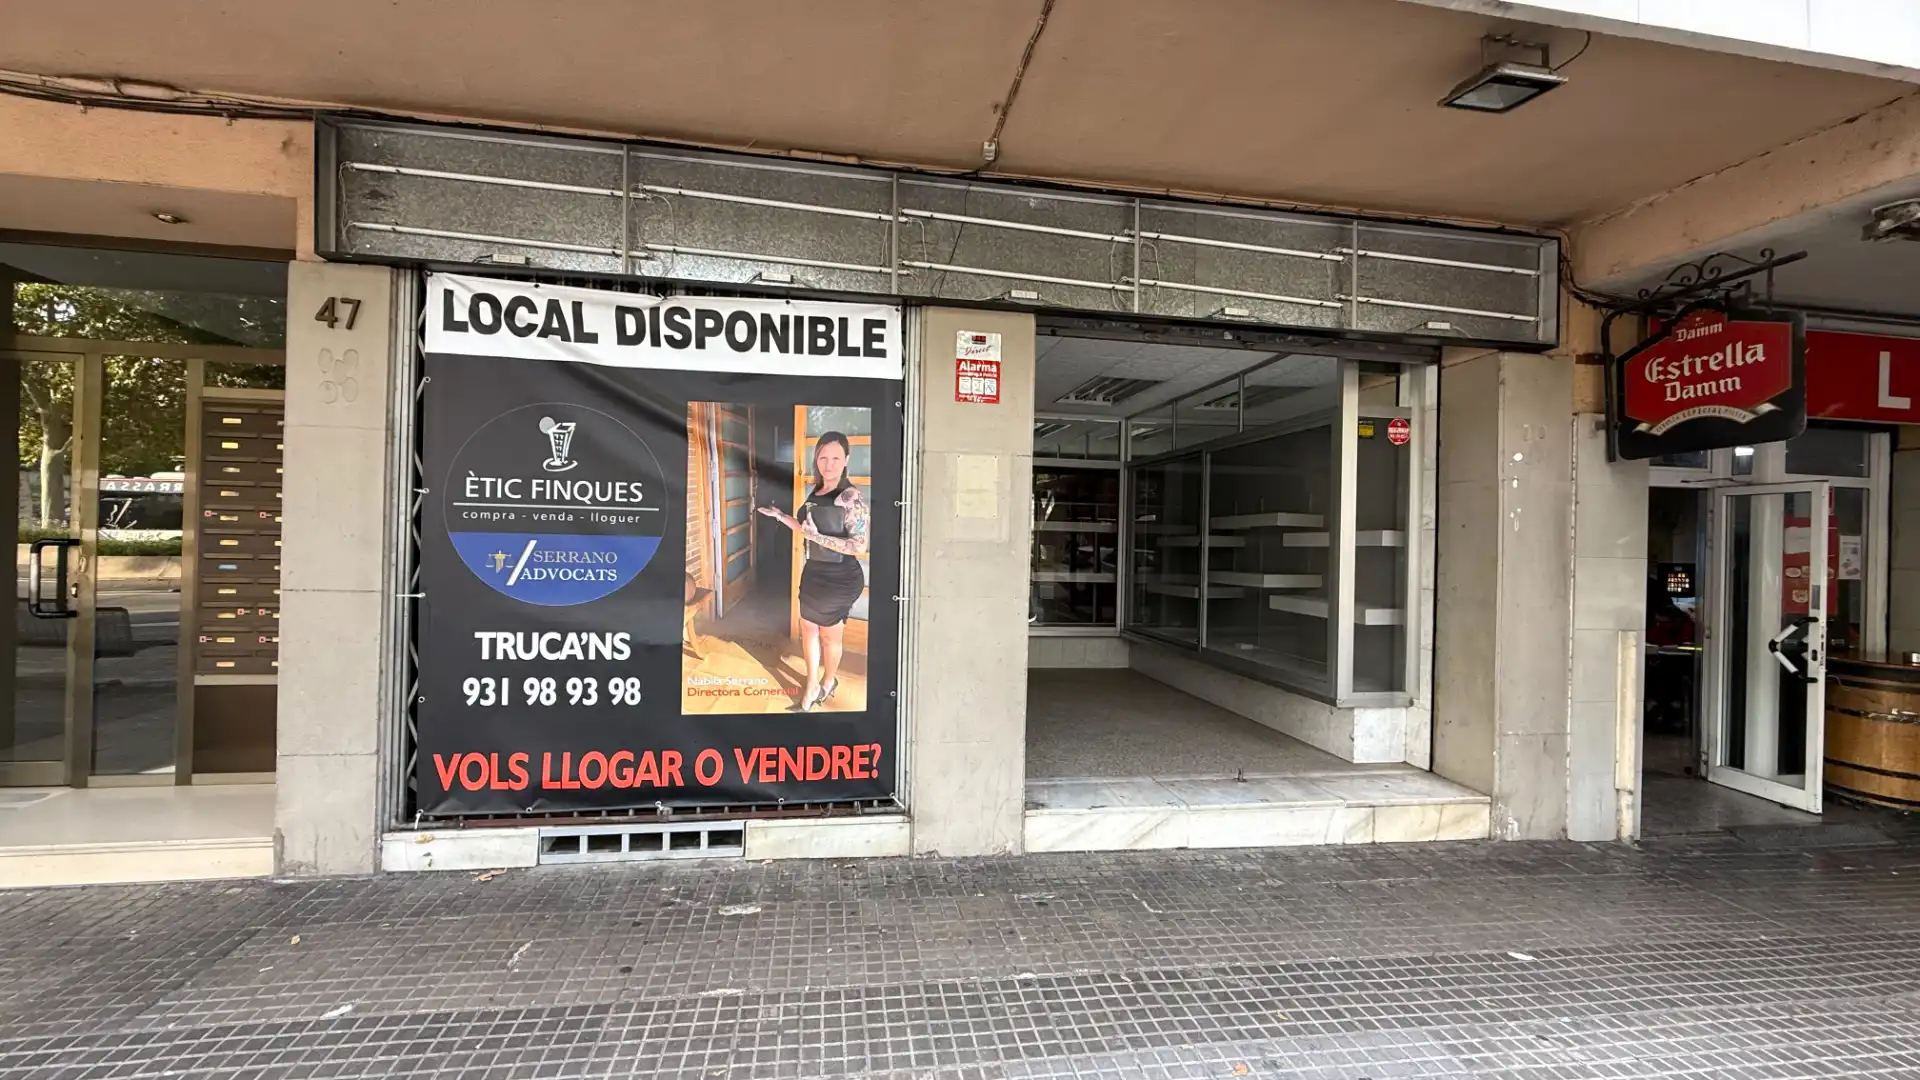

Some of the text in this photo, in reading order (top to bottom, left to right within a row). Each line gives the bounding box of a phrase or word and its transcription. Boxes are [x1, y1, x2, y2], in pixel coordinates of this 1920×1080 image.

[314, 296, 362, 330] 47
[443, 289, 888, 359] LOCAL DISPONIBLE
[1675, 321, 1723, 342] Damm
[959, 361, 997, 372] Alarma
[1645, 340, 1766, 383] Estrella
[1664, 375, 1741, 402] Damm
[1877, 350, 1912, 410] L
[465, 470, 643, 504] ÈTIC FINQUES
[462, 510, 515, 522] compra
[532, 511, 574, 522] venda
[590, 512, 640, 525] lloguer
[533, 550, 618, 564] SERRANO
[520, 568, 618, 581] ADVOCATS
[474, 631, 631, 661] TRUCA'NS
[462, 676, 641, 707] 931 98 93 98
[687, 686, 800, 697] Directora Comercial
[433, 743, 882, 791] VOLS LLOGAR O VENDRE?
